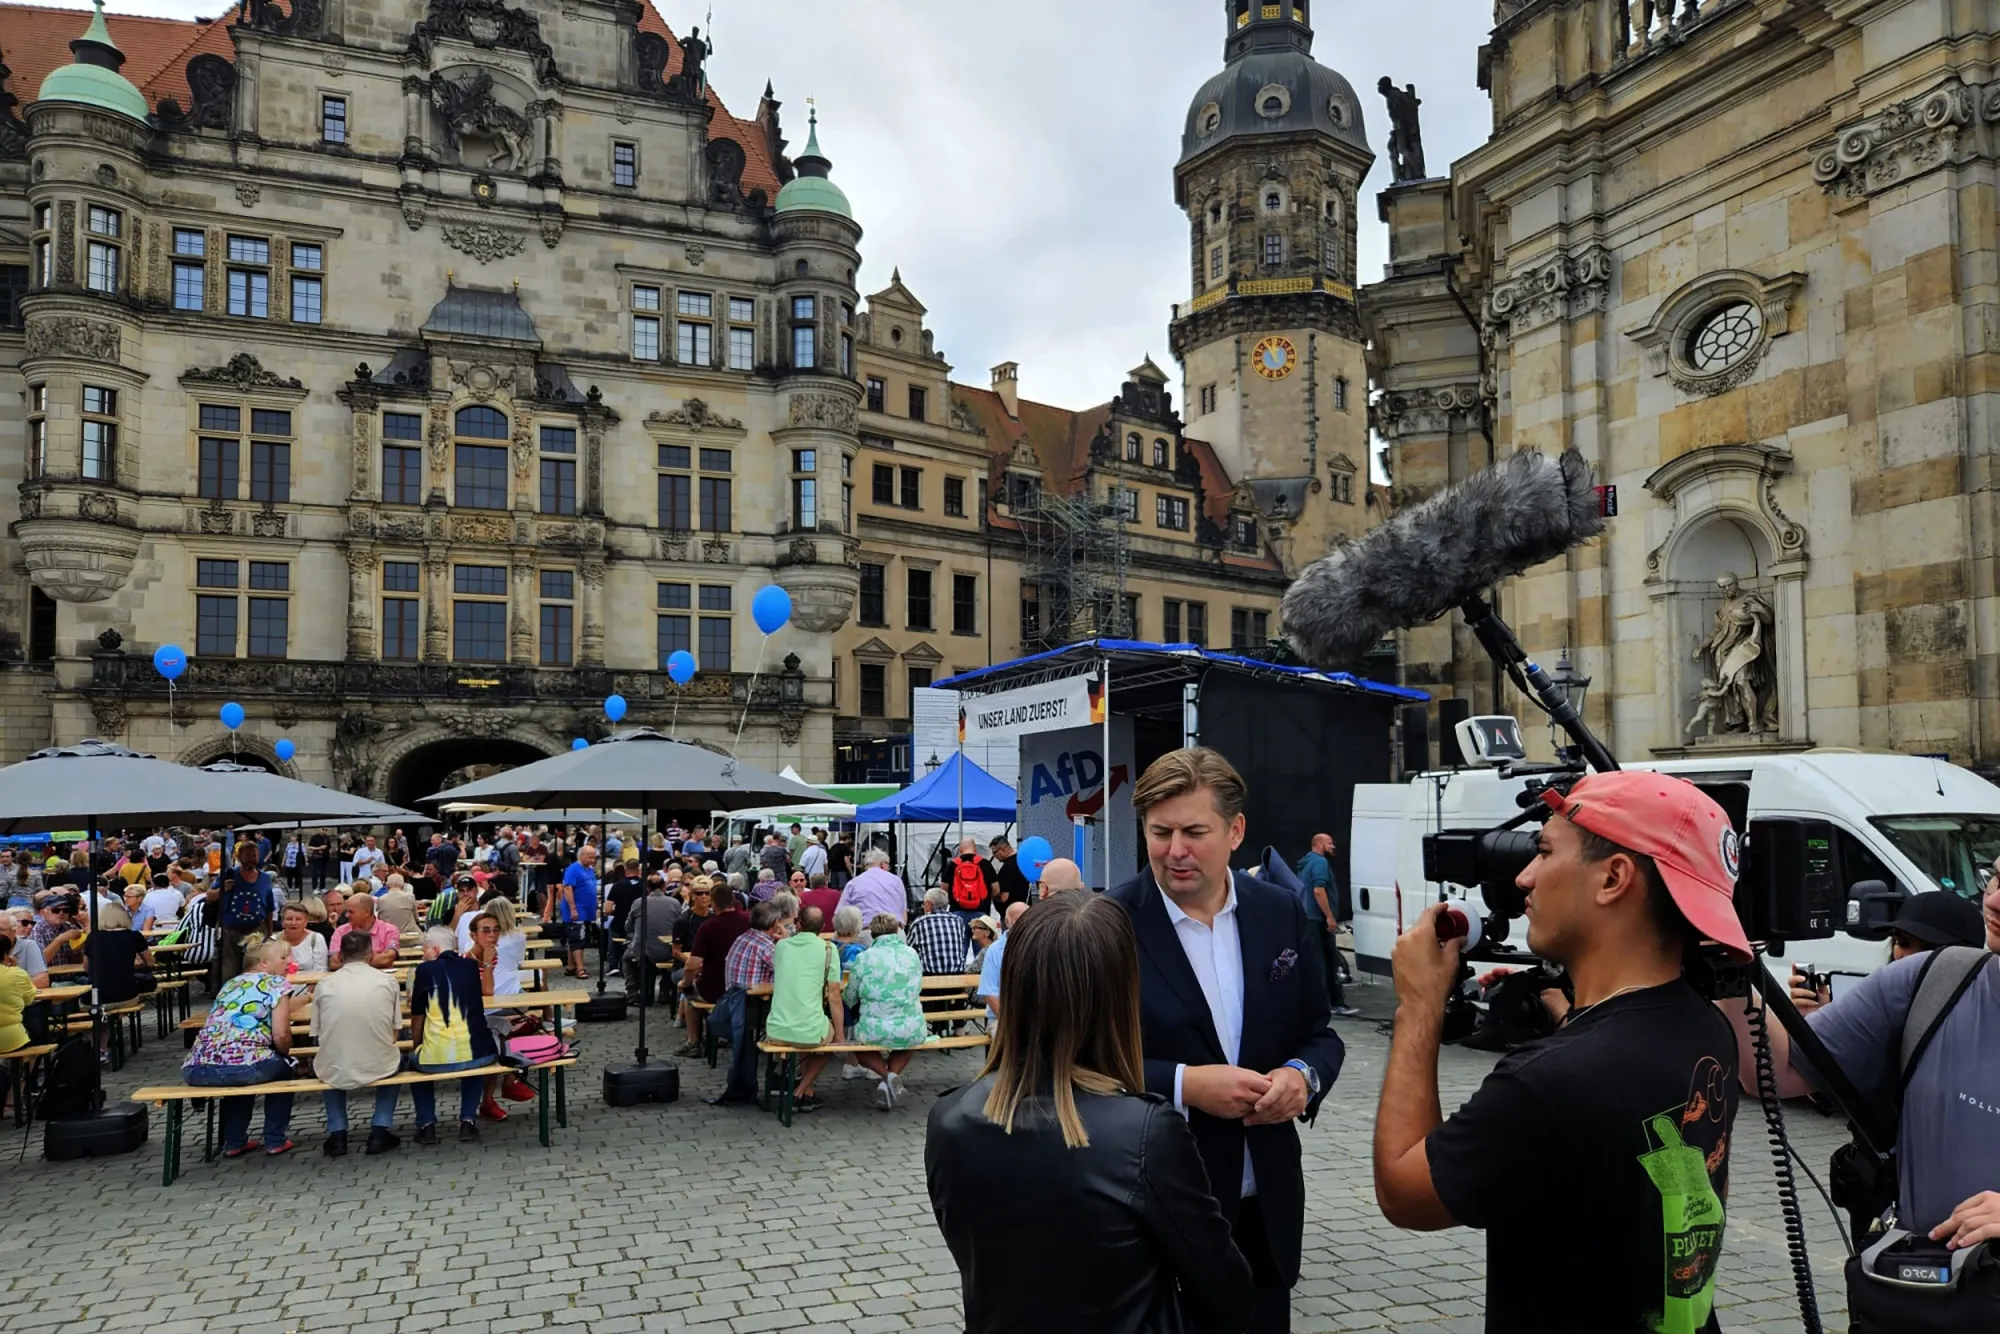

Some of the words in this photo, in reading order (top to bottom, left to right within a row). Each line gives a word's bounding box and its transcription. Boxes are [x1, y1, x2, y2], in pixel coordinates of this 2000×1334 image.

[978, 710, 1003, 729] UNSER
[1004, 706, 1028, 725] LAND
[1029, 698, 1068, 721] ZUERST!
[1031, 749, 1105, 806] AfD
[1671, 1230, 1717, 1257] PLET
[1902, 1268, 1937, 1280] ORCA
